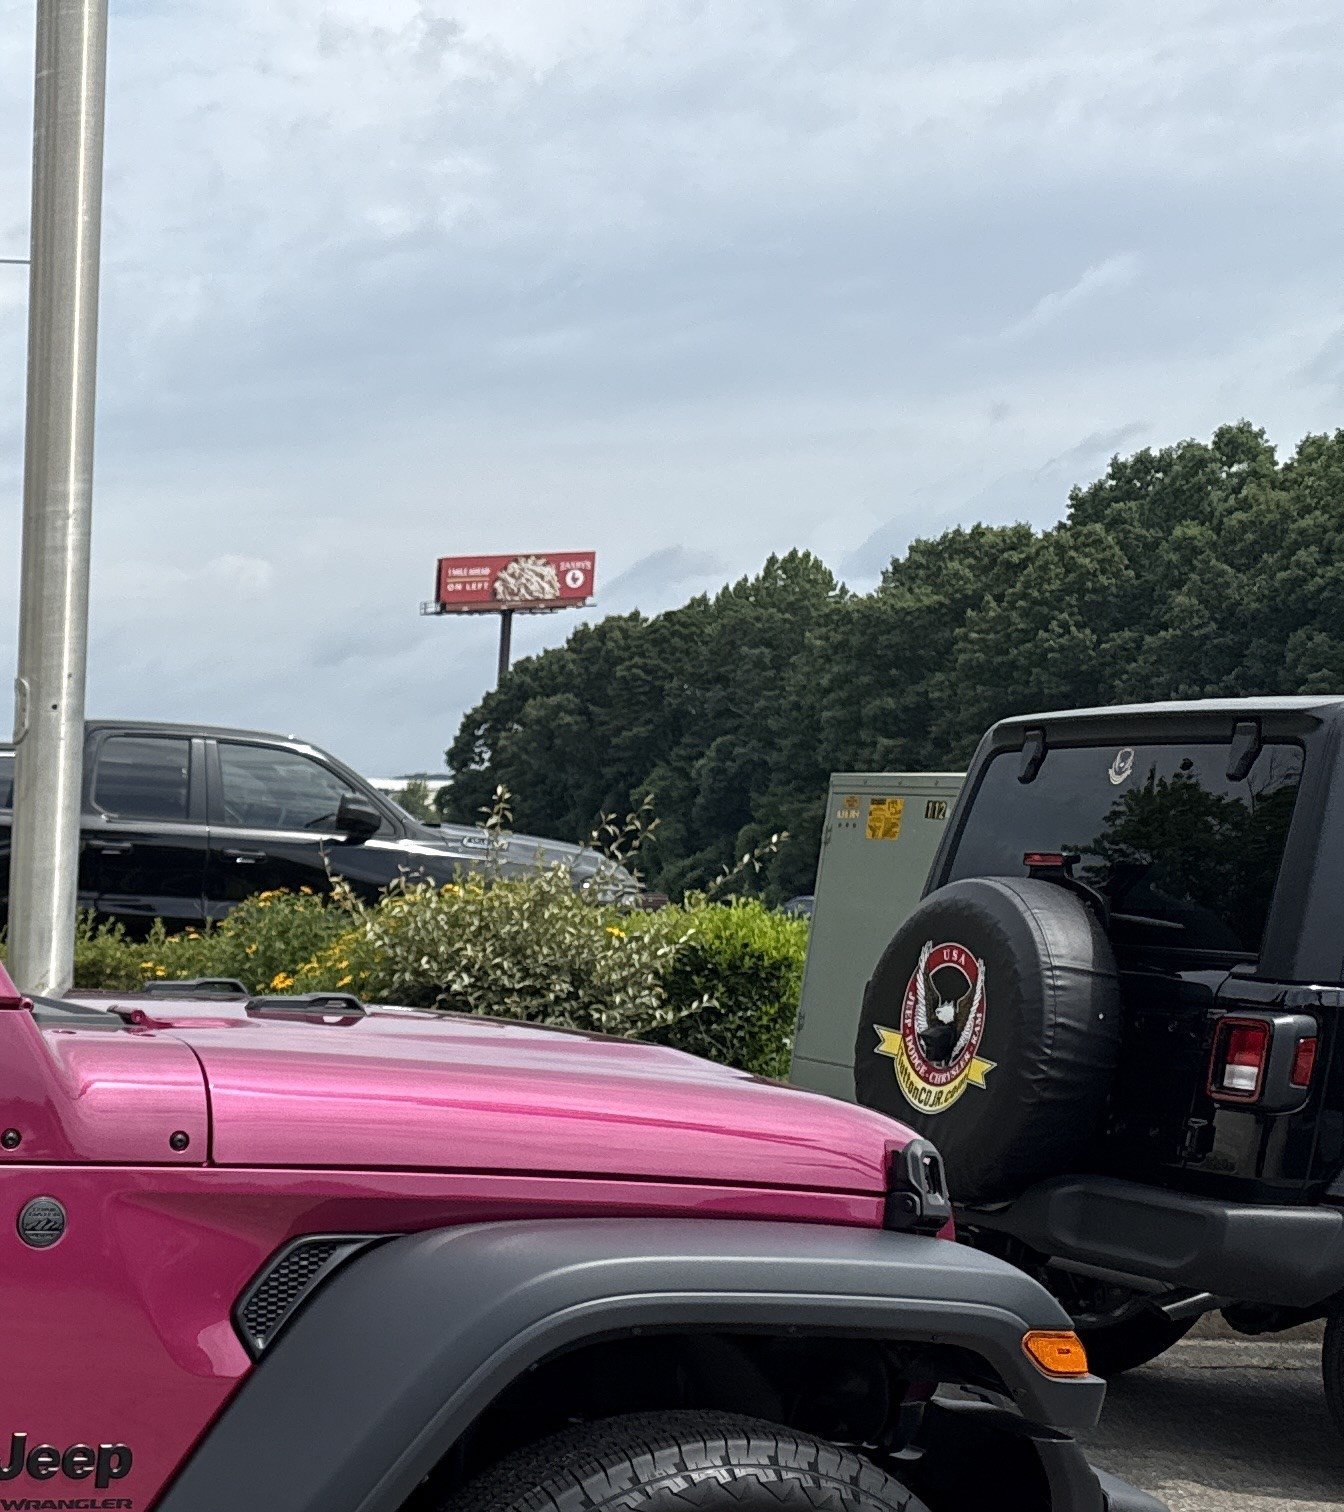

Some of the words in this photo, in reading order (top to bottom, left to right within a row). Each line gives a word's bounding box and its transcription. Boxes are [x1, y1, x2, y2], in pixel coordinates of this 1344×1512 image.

[927, 800, 947, 820] 112
[943, 949, 965, 966] USA
[904, 991, 916, 1028] JEEP
[971, 1012, 983, 1045] RAM
[906, 1035, 928, 1077] DODGE
[0, 1499, 133, 1511] WRANGLER
